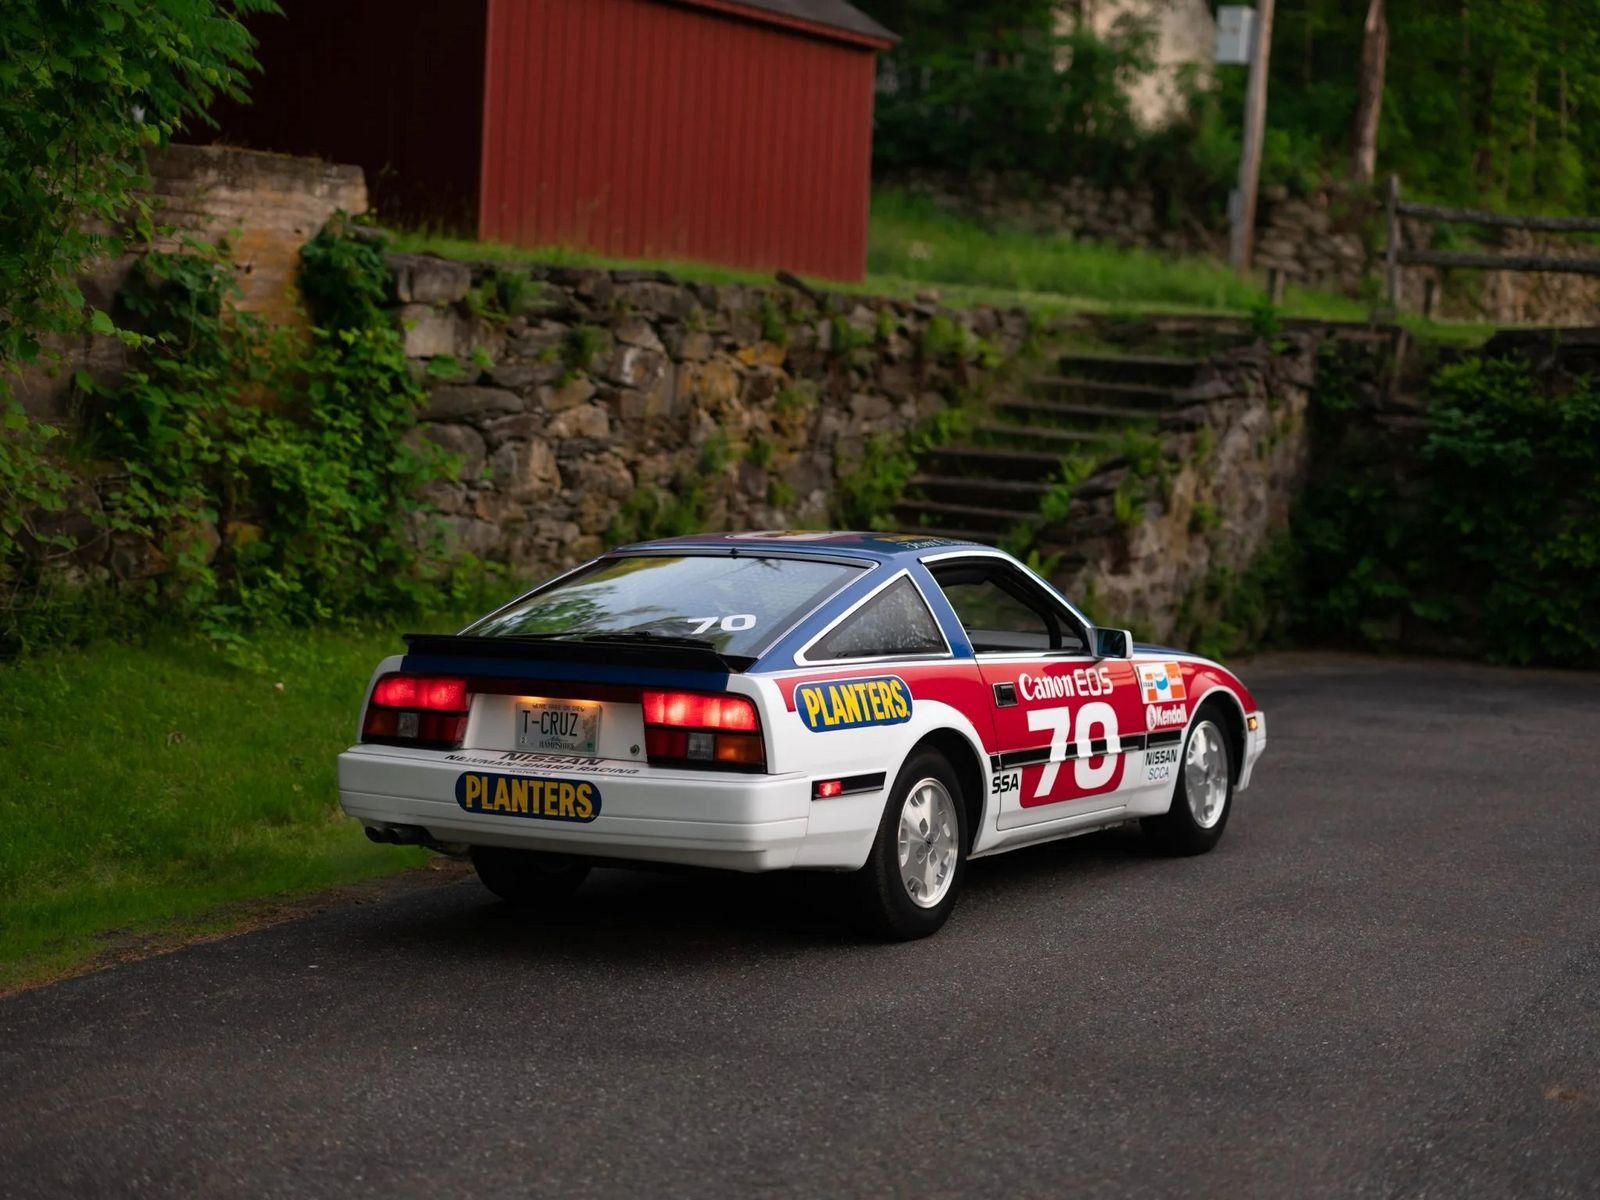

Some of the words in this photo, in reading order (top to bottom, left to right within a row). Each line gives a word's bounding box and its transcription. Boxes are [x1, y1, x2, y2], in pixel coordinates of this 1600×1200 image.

[687, 614, 757, 635] 70
[1018, 672, 1076, 701] Canon
[1073, 667, 1114, 697] EOS
[800, 679, 907, 728] PLANTERS
[1156, 703, 1188, 727] Kendall
[521, 709, 579, 737] T-CRUZ
[499, 752, 605, 766] NISSAN
[1026, 701, 1121, 798] 70
[1144, 748, 1178, 766] NISSAN
[444, 754, 574, 770] NEWMAN-SHARP
[576, 766, 641, 775] RACING
[1147, 766, 1169, 781] SCCA
[991, 773, 1019, 795] SSA
[465, 774, 593, 819] PLANTERS
